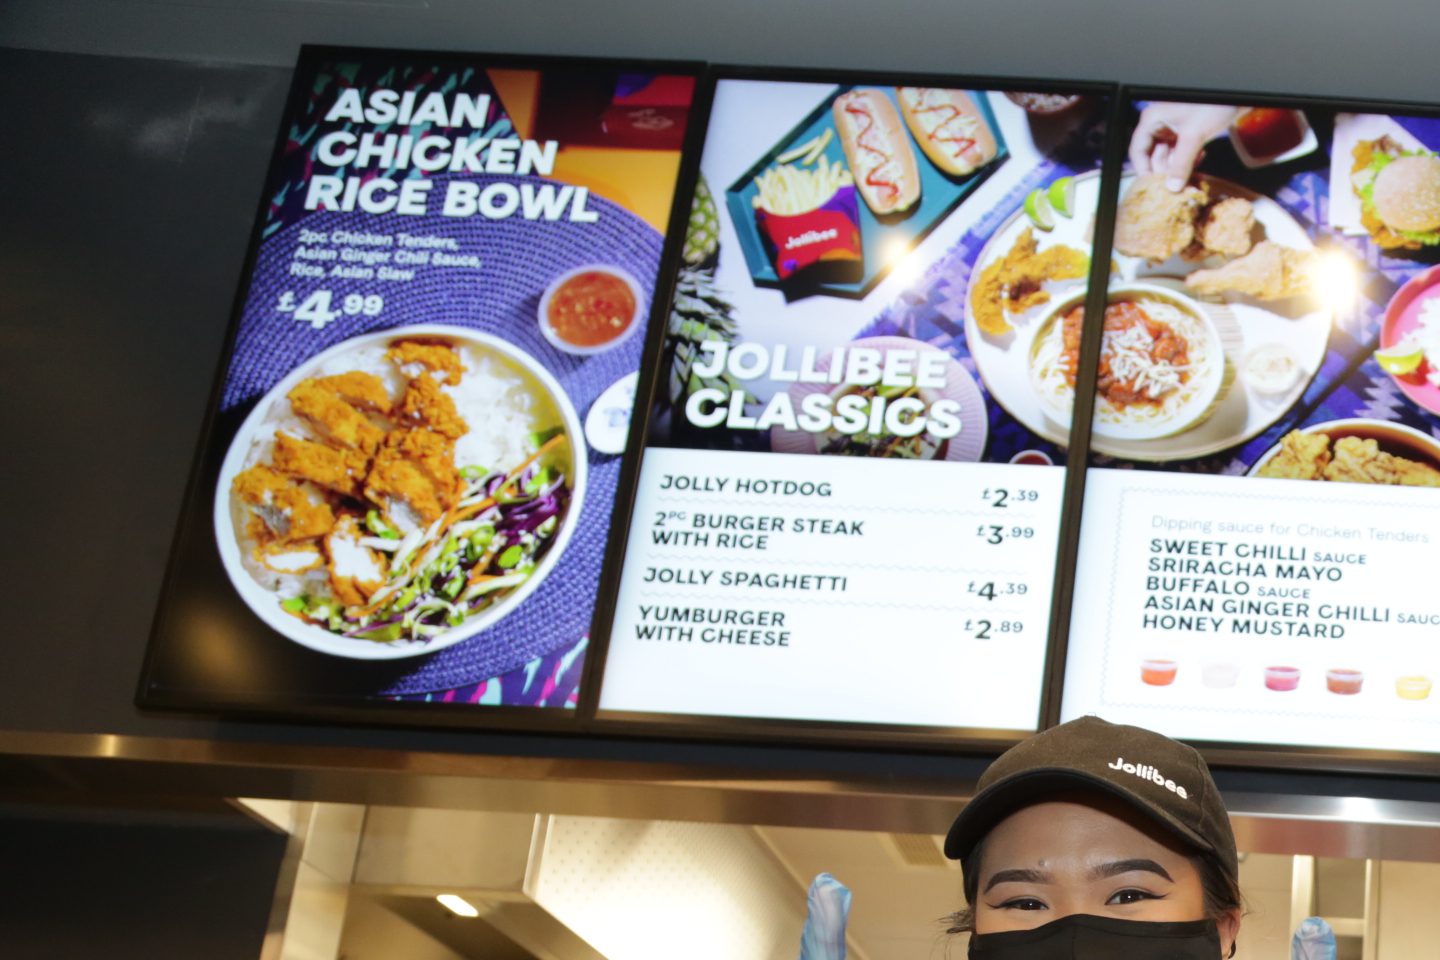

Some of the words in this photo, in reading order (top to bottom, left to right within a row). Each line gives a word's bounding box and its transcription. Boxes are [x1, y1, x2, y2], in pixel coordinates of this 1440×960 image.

[326, 89, 489, 127] ASIAN
[318, 134, 557, 175] CHICKEN
[305, 176, 433, 214] RICE
[443, 181, 598, 221] BOWL
[299, 229, 327, 245] 2pc
[331, 231, 393, 247] Chicken
[786, 229, 836, 249] Jollibee
[294, 246, 337, 260] Asian
[341, 248, 391, 265] Ginger
[330, 265, 374, 279] Asian
[377, 266, 415, 280] Slaw
[277, 290, 383, 328] £4.99
[692, 341, 951, 388] JOLLIBEE
[686, 390, 962, 438] CLASSICS
[660, 474, 729, 492] JOLLY
[735, 478, 832, 497] HOTDOG
[982, 489, 1038, 507] £2.39
[693, 514, 785, 532] BURGER
[792, 518, 865, 536] STEAK
[977, 525, 1033, 544] £3.99
[1152, 515, 1212, 534] Dipping
[1217, 521, 1264, 534] sauce
[1270, 521, 1291, 535] for
[1296, 523, 1361, 539] Chicken
[1367, 527, 1430, 544] Tenders
[651, 529, 710, 548] WITH
[716, 533, 769, 550] RICE
[1150, 538, 1228, 557] SWEET
[1235, 543, 1306, 561] CHILLI
[1313, 551, 1367, 565] SAUCE
[643, 567, 713, 585] JOLLY
[721, 571, 847, 591] SPAGHETTI
[1149, 558, 1266, 577] SRIRACHA
[1276, 564, 1342, 582] MAYO
[968, 582, 1027, 600] £4.39
[1147, 577, 1249, 595] BUFFALO
[1257, 586, 1311, 600] SAUCE
[640, 606, 784, 627] YUMBURGER
[1144, 595, 1214, 613] ASIAN
[1222, 599, 1309, 618] GINGER
[1318, 604, 1390, 622] CHILLI
[635, 626, 694, 643] WITH
[701, 628, 790, 646] CHEESE
[965, 619, 1022, 639] £2.89
[1143, 614, 1224, 632] HONEY
[1233, 619, 1344, 638] MUSTARD
[1109, 758, 1187, 799] Jollibee
